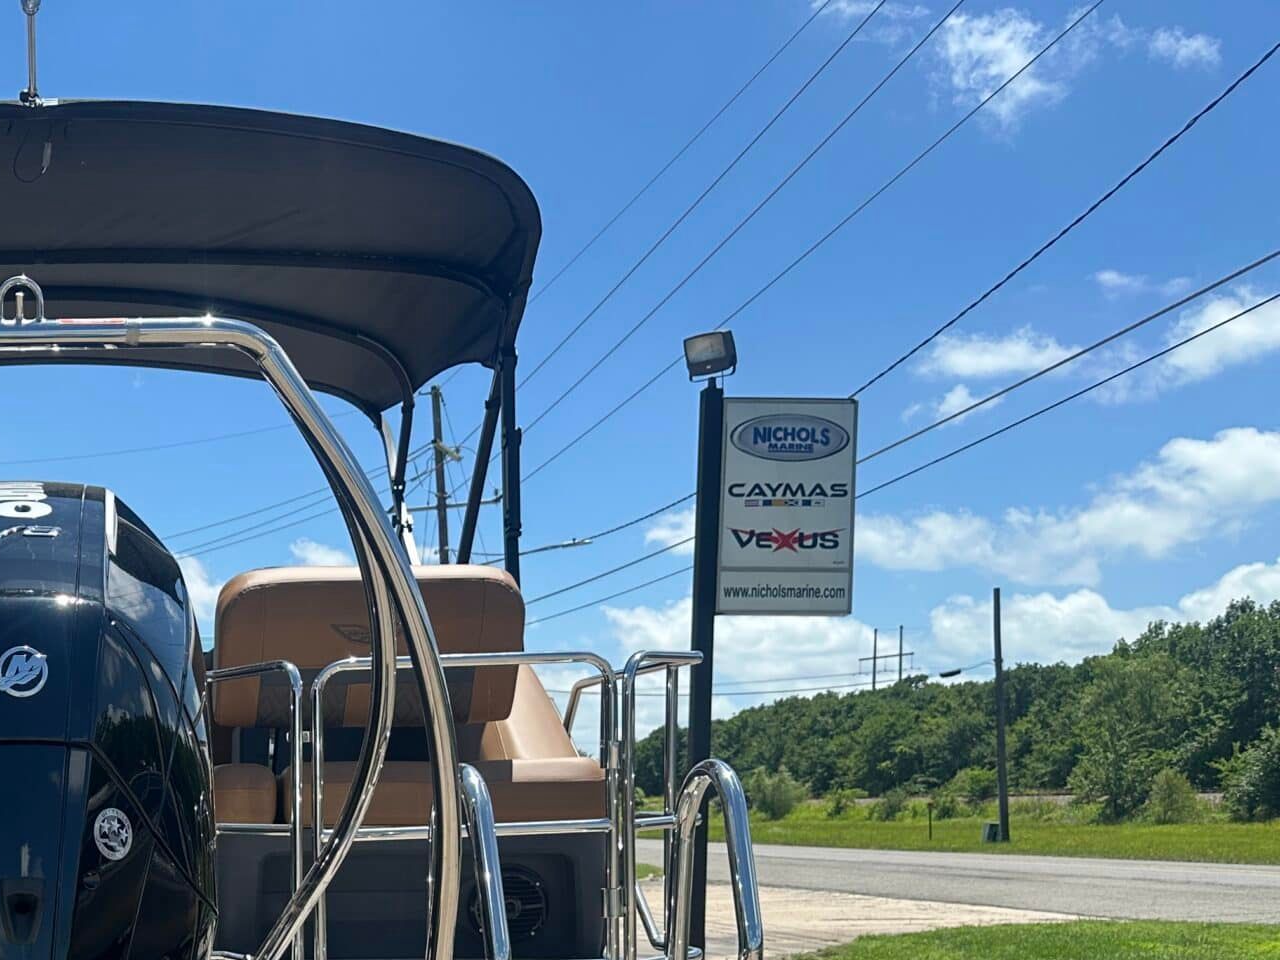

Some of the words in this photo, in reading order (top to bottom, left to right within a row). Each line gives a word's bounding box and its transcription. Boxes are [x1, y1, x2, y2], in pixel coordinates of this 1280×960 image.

[753, 427, 831, 446] NICHOLS
[767, 442, 814, 450] MARINE
[728, 483, 849, 497] CAYMAS
[728, 527, 847, 552] VEXUS
[723, 584, 846, 599] www.nicholsmarine.com
